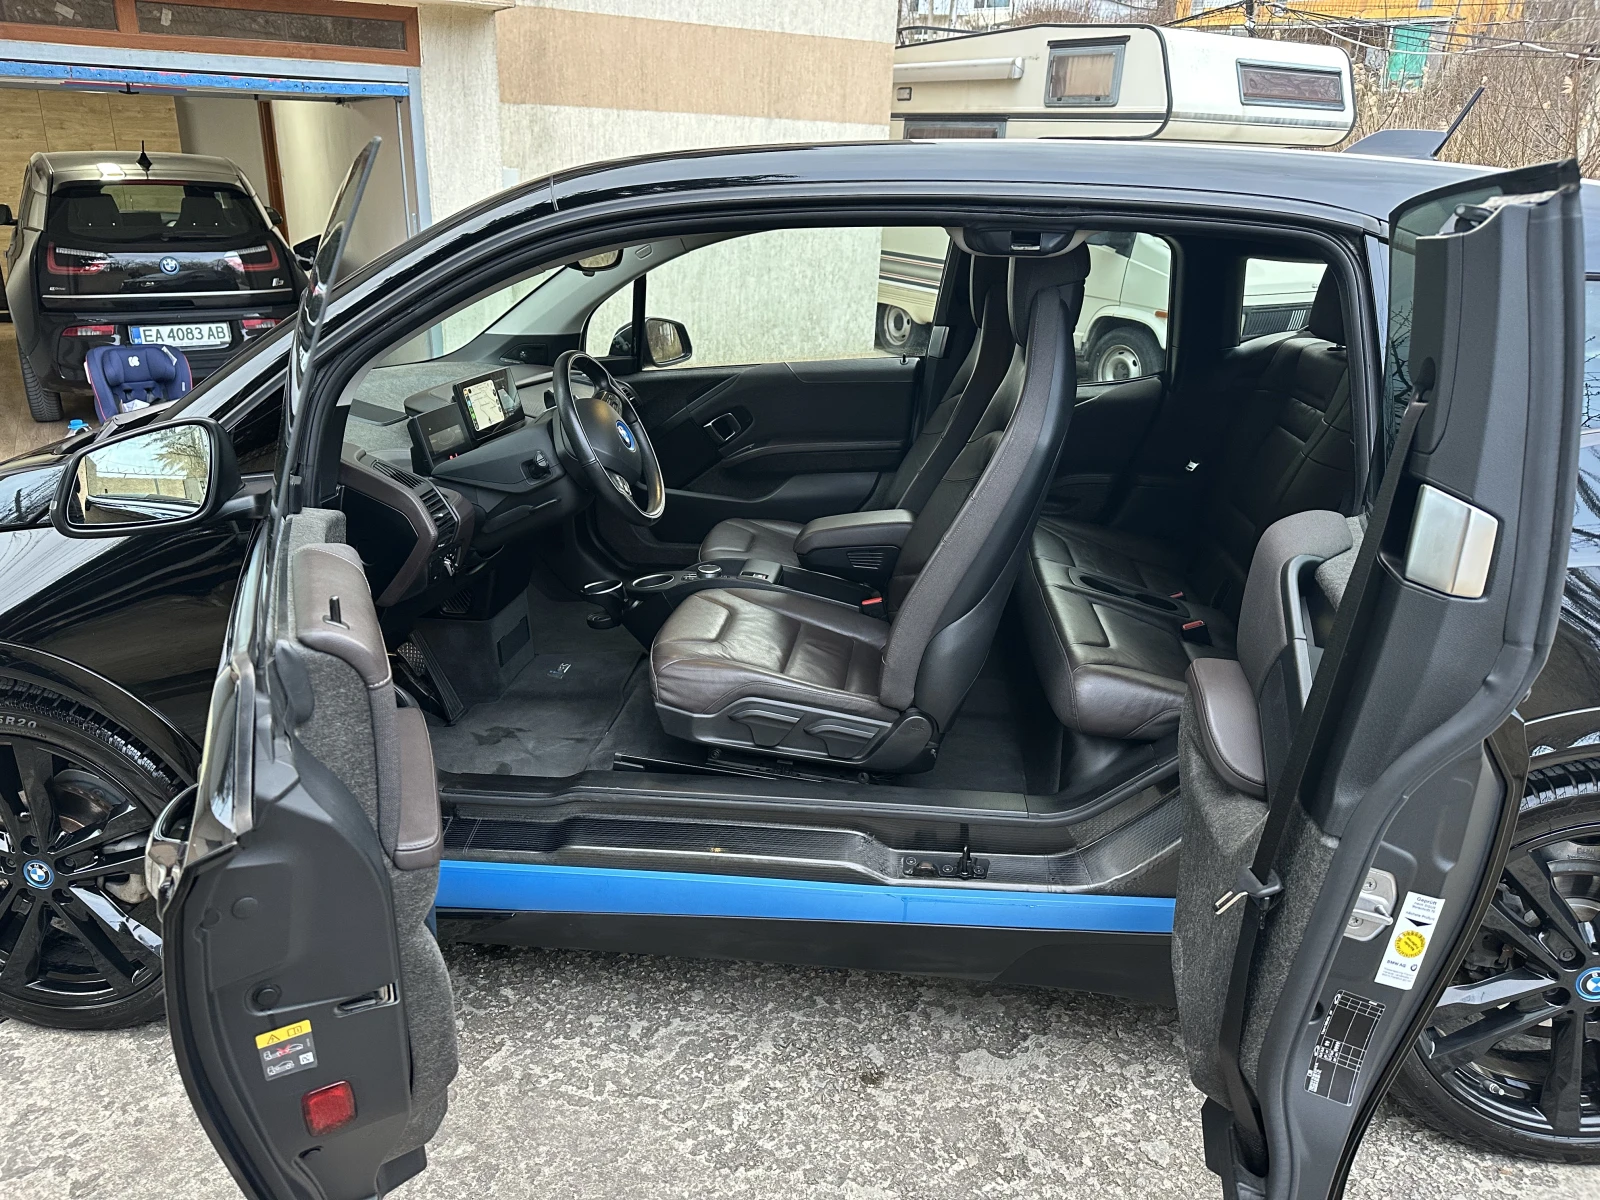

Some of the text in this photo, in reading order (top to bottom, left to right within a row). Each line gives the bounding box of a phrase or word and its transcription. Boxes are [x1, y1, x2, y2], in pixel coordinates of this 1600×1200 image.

[142, 325, 226, 343] EA 4083 AB
